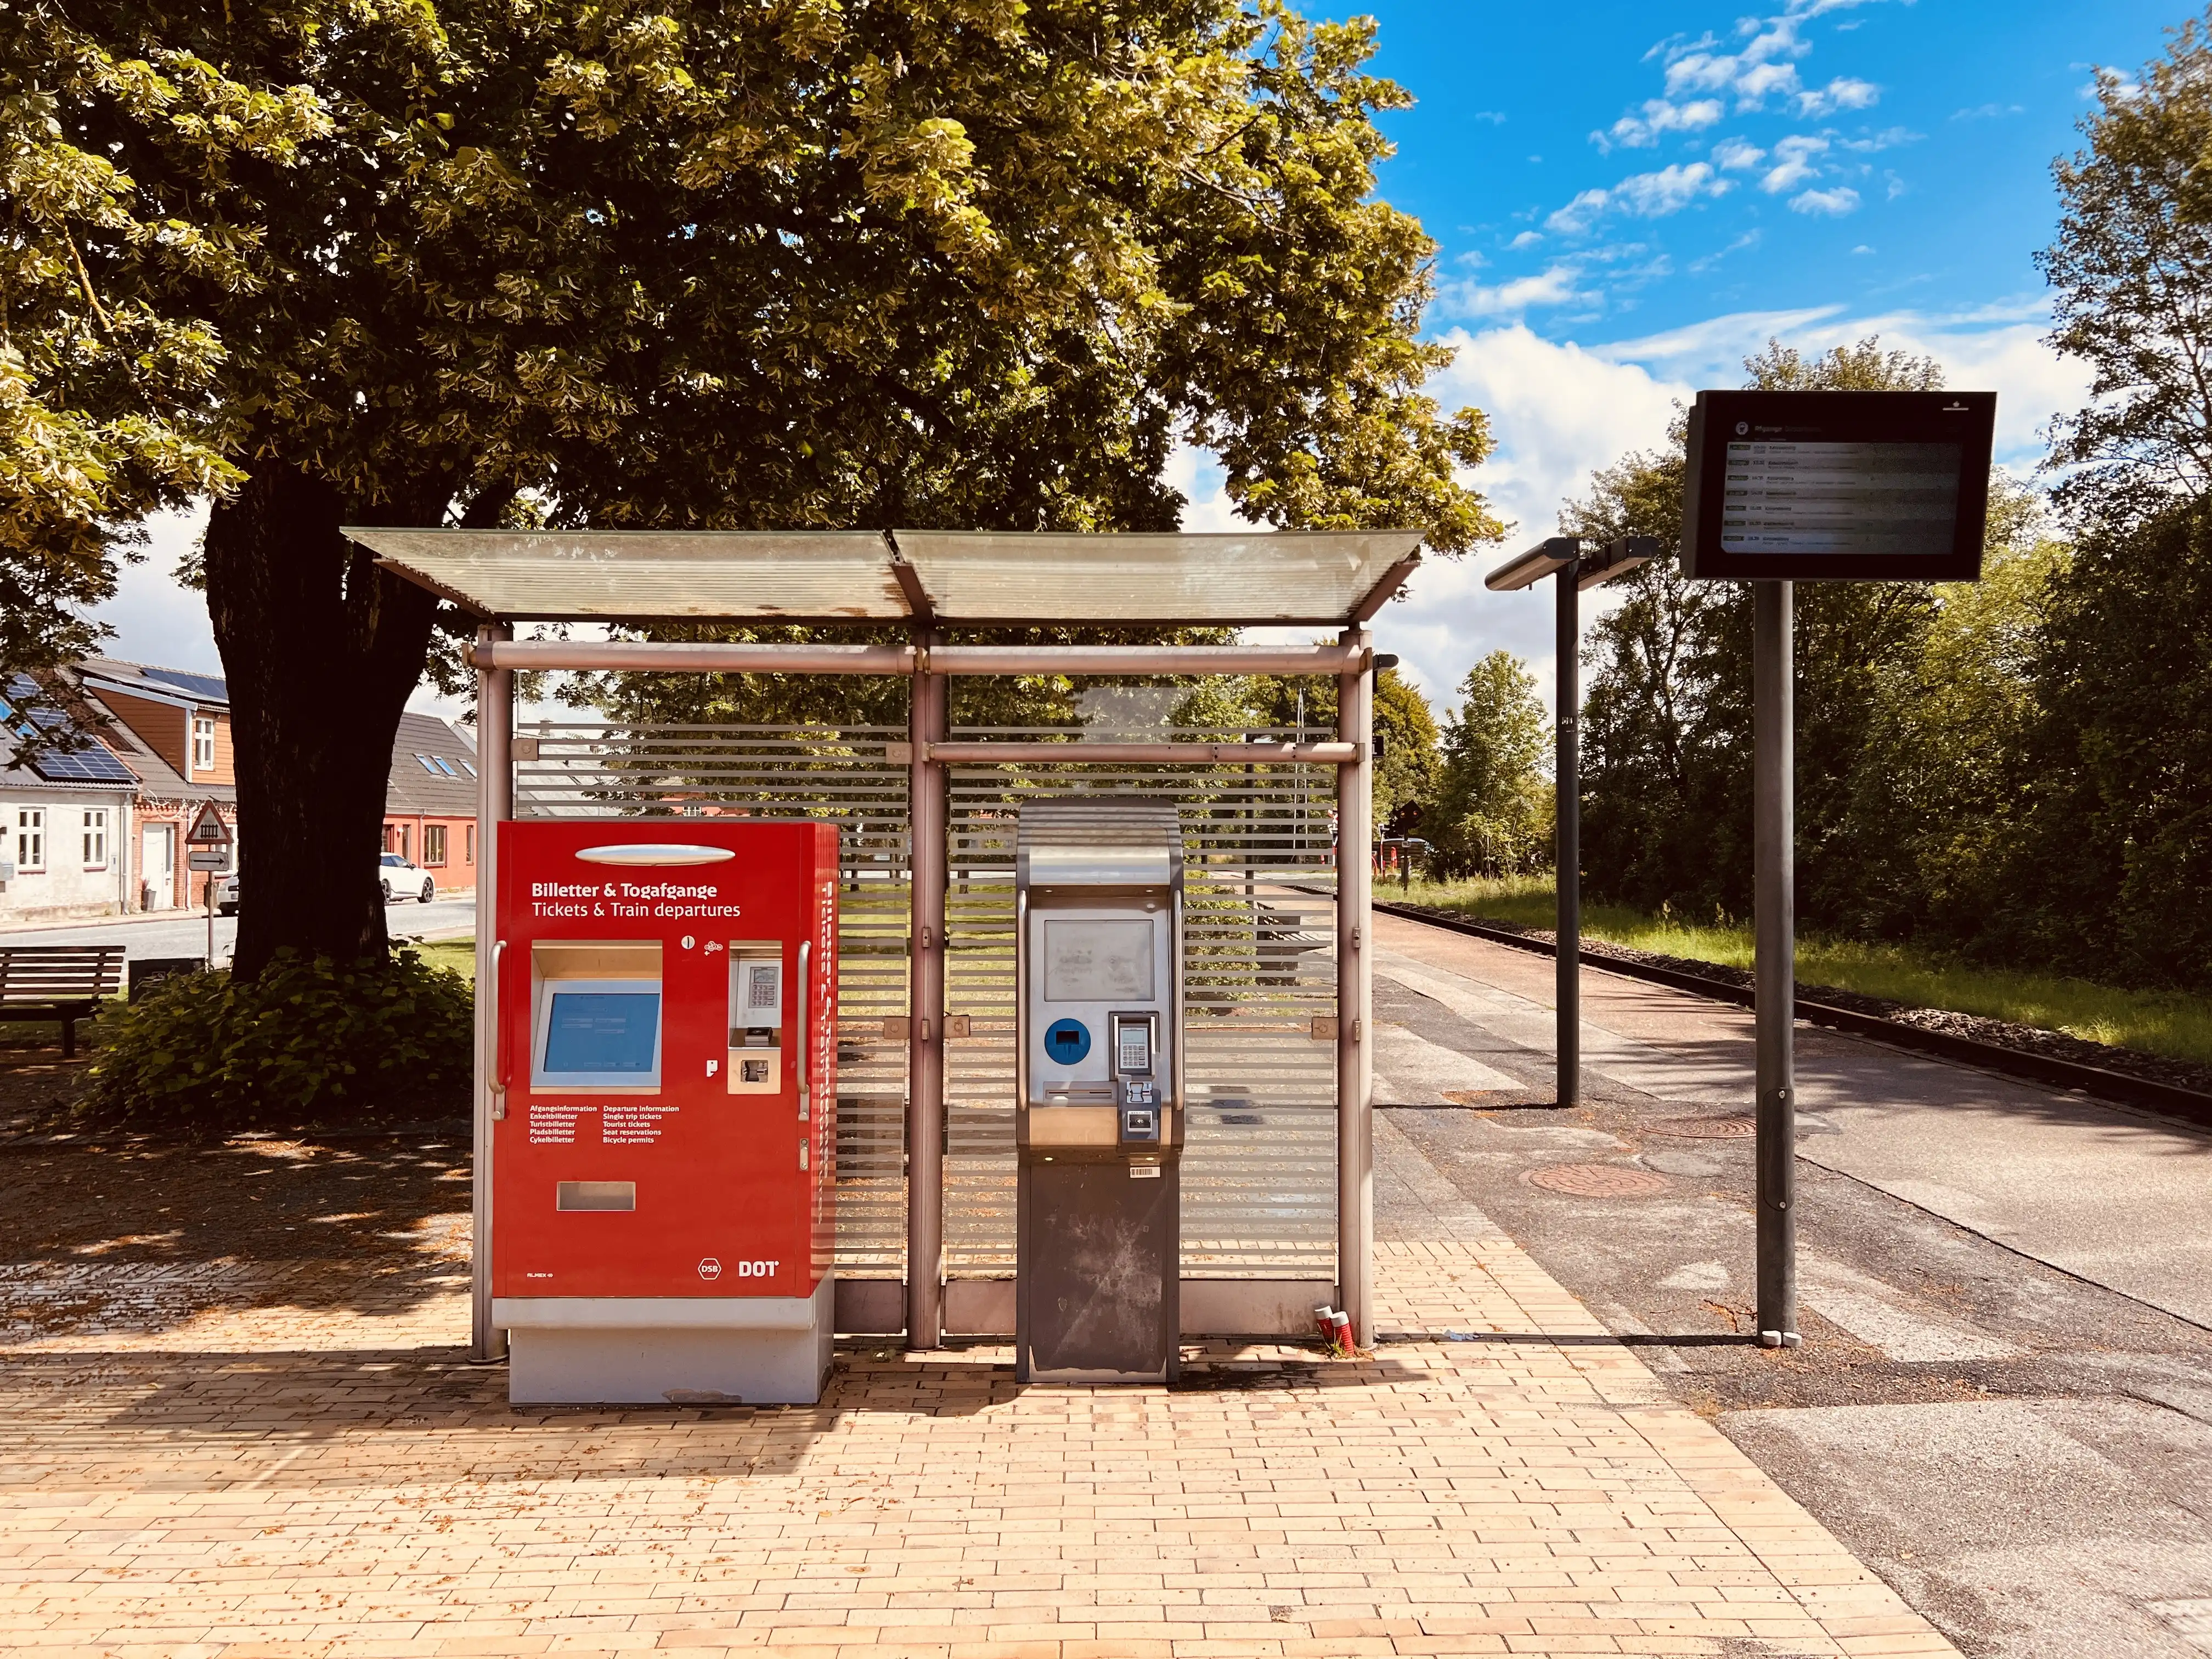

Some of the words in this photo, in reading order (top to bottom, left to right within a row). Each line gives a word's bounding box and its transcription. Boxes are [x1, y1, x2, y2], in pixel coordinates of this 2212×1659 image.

[532, 883, 599, 897] Billetter
[603, 883, 617, 897] &
[620, 883, 718, 900] Togafgange
[532, 902, 588, 916] Tickets
[593, 902, 605, 916] &
[610, 902, 649, 916] Train
[654, 902, 741, 920] departures
[529, 1105, 597, 1113] Afgangsinformation
[603, 1105, 638, 1113] Departure
[738, 1261, 780, 1277] DOT
